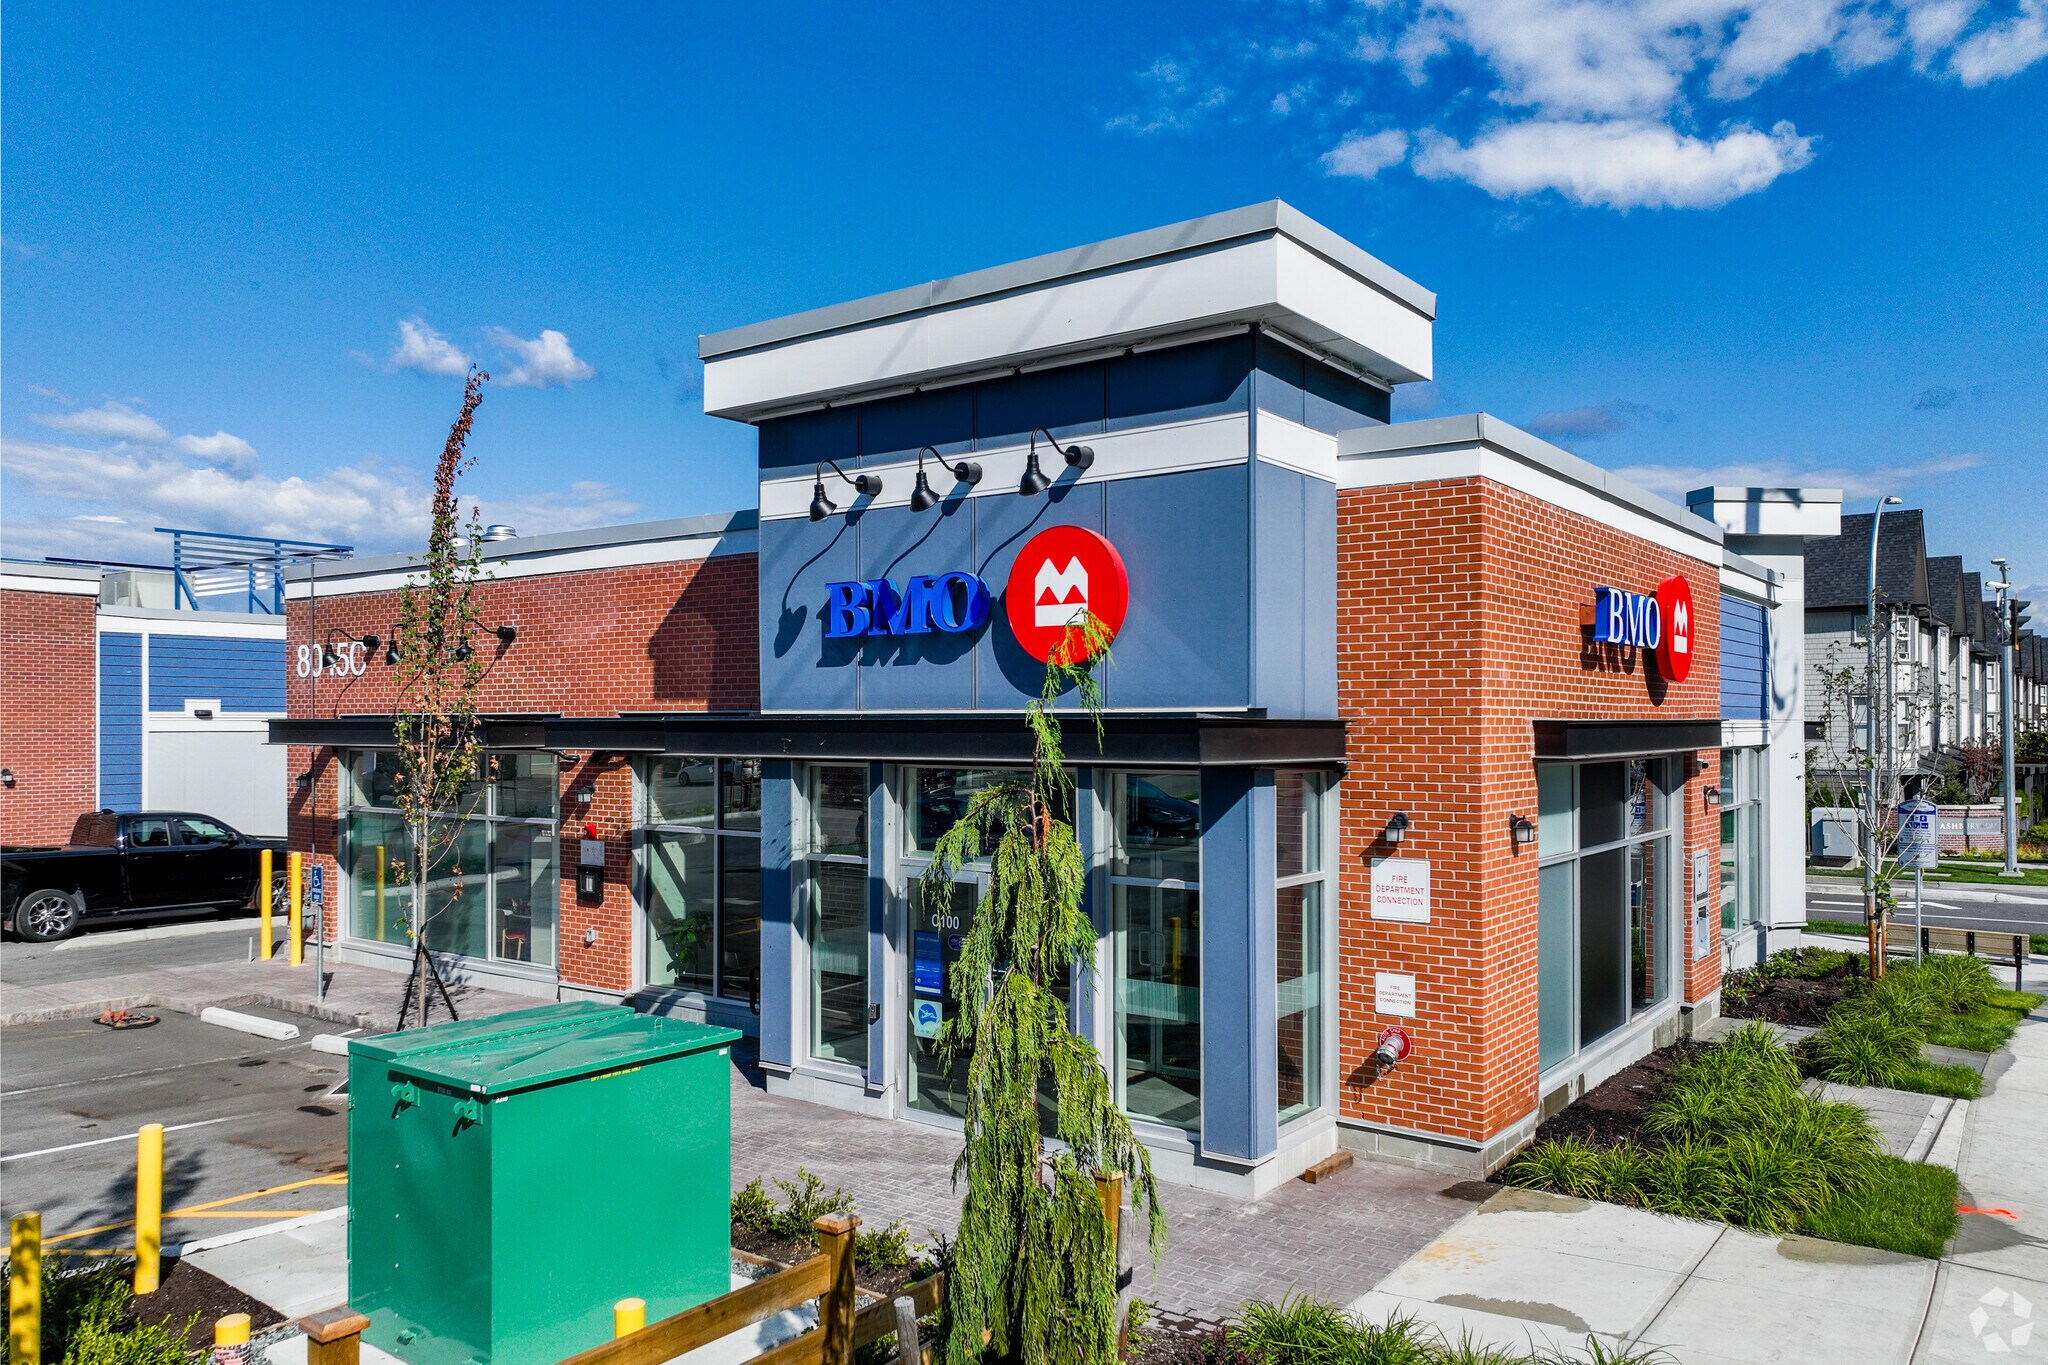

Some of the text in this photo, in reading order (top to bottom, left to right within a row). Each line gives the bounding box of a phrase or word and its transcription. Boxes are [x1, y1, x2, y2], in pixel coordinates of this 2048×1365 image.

[825, 571, 987, 638] BMO
[1608, 587, 1661, 650] BMO
[1391, 874, 1408, 884] FIRE
[1375, 885, 1425, 895] DEPARTMENT
[1376, 896, 1424, 906] CONNECTION
[1378, 990, 1412, 999] DEPARTMENT
[1379, 997, 1412, 1005] CONNECTION
